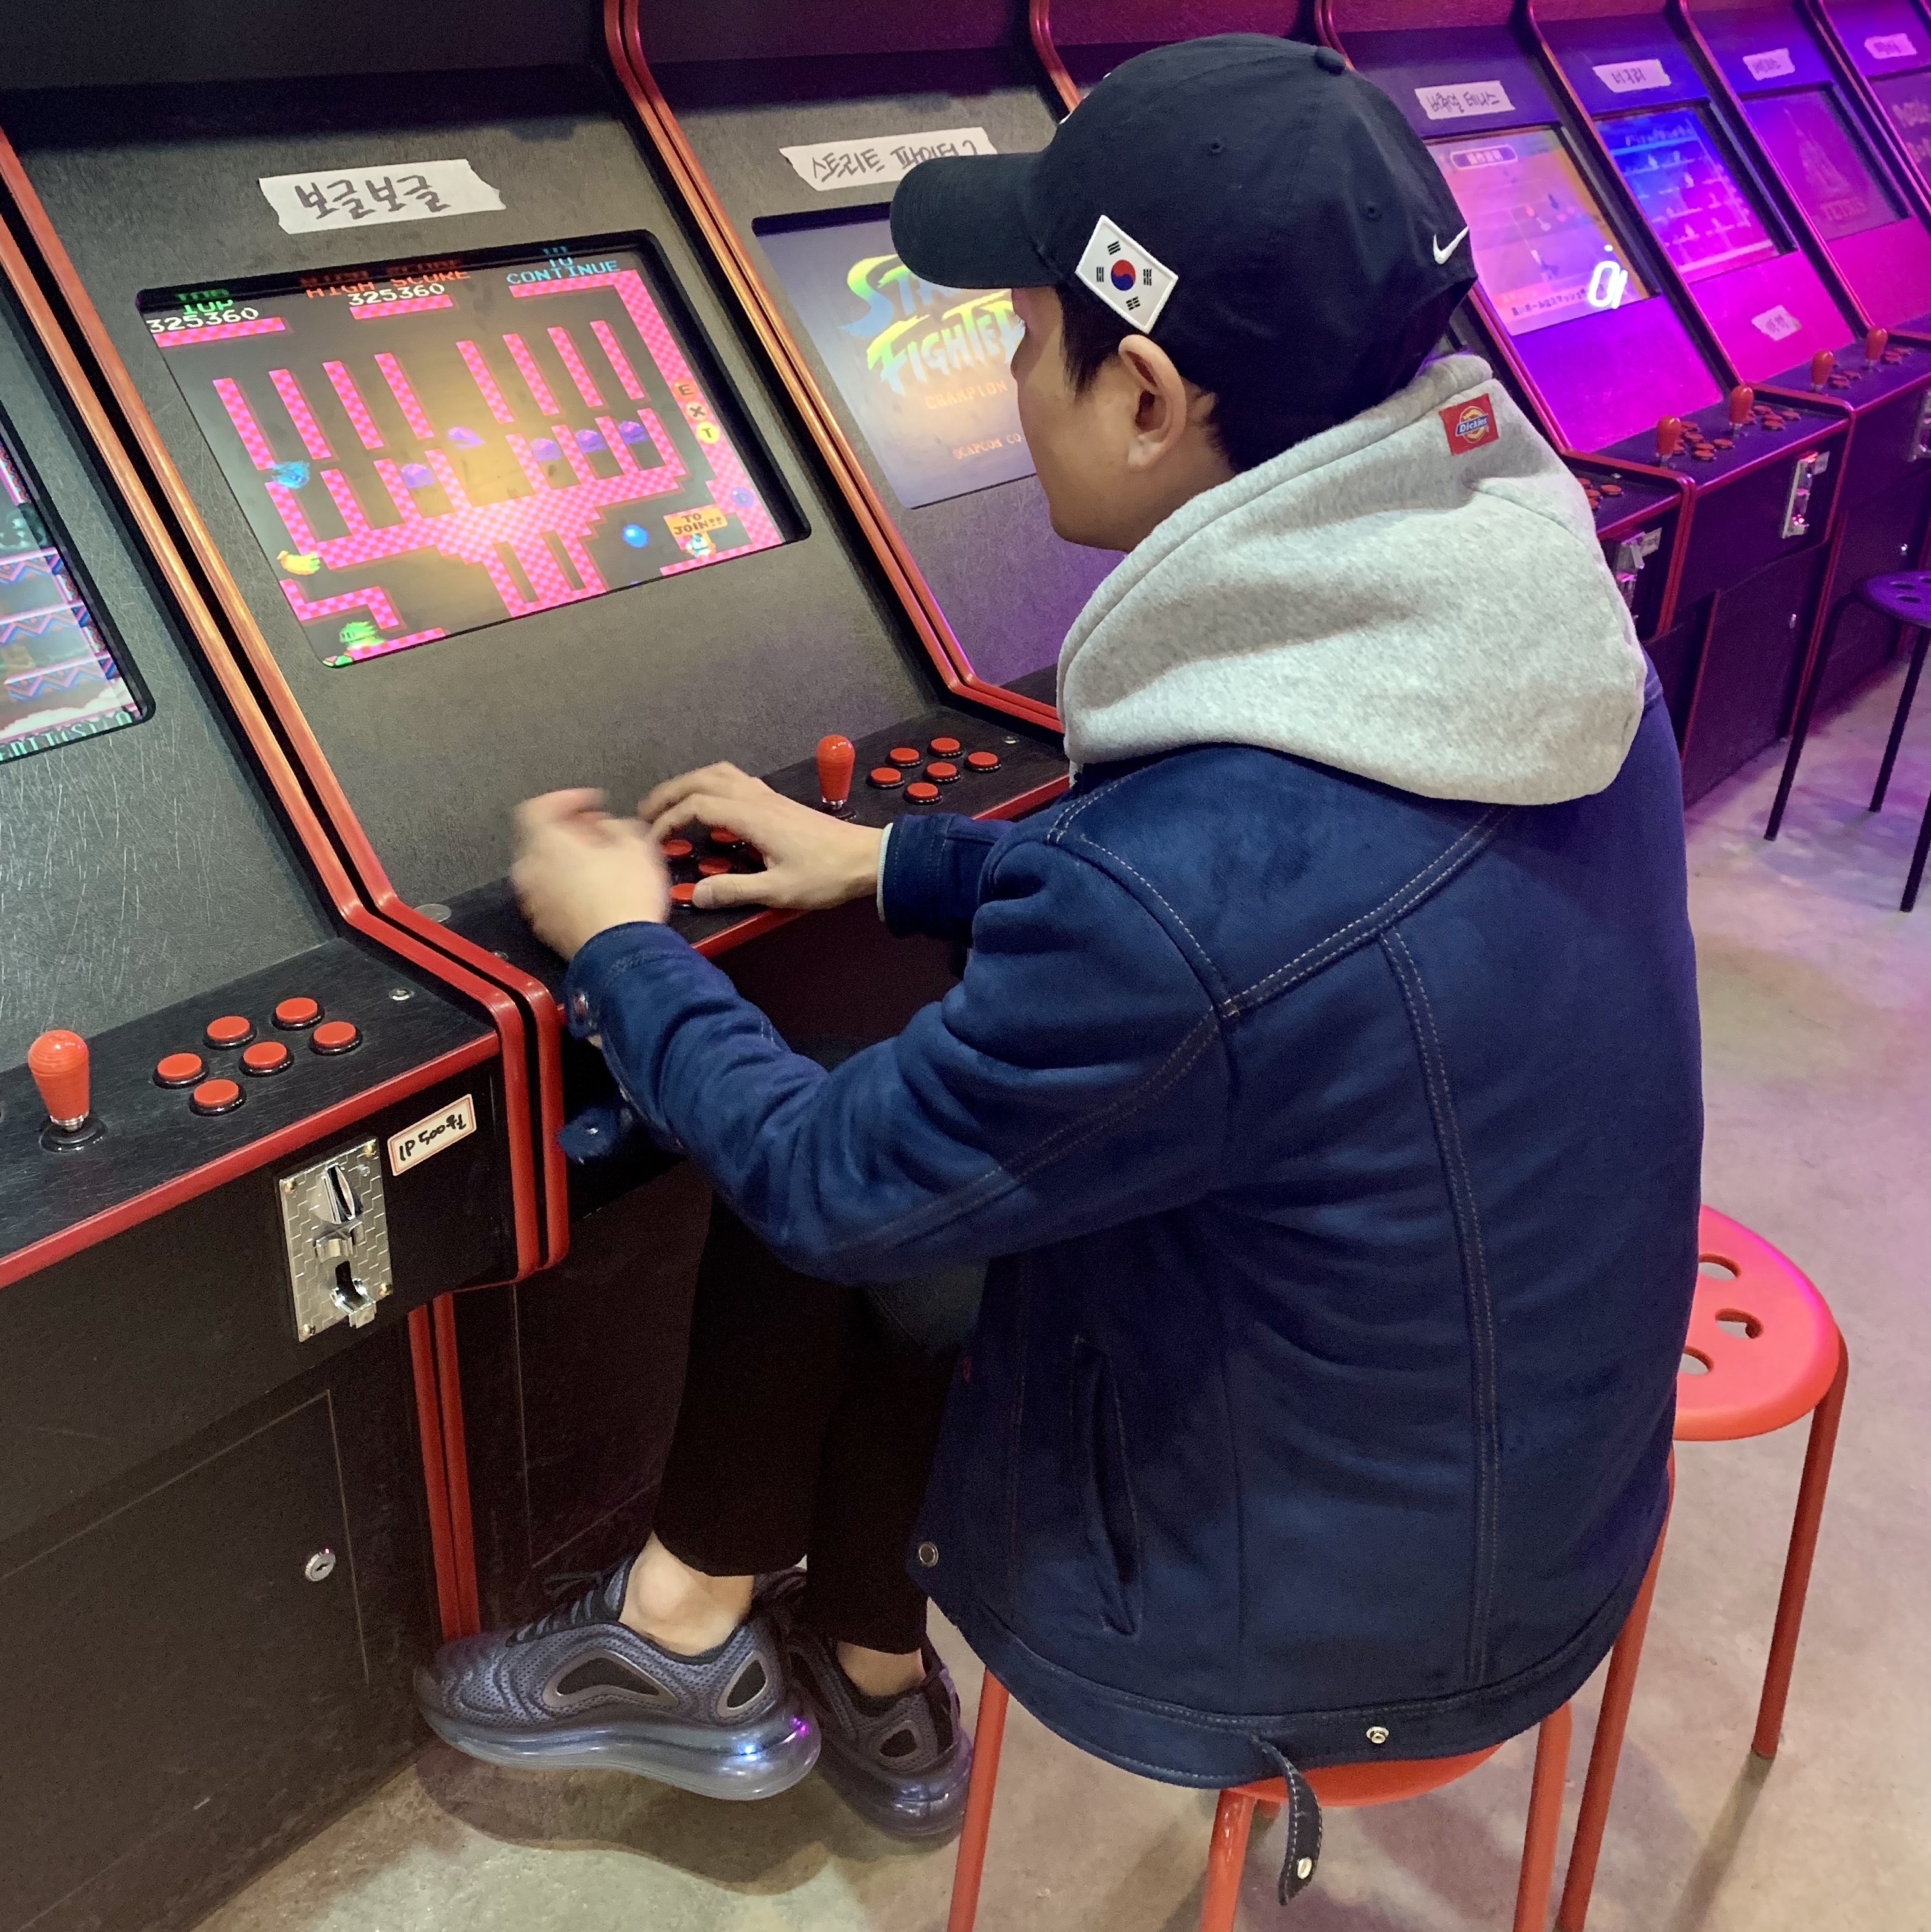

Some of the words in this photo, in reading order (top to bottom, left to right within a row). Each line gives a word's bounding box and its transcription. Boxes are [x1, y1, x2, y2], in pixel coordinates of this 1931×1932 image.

[294, 174, 451, 220] 보글보글
[506, 260, 620, 285] CONTINUE
[347, 283, 445, 306] 325360
[146, 307, 259, 333] 325360
[681, 513, 702, 524] TO
